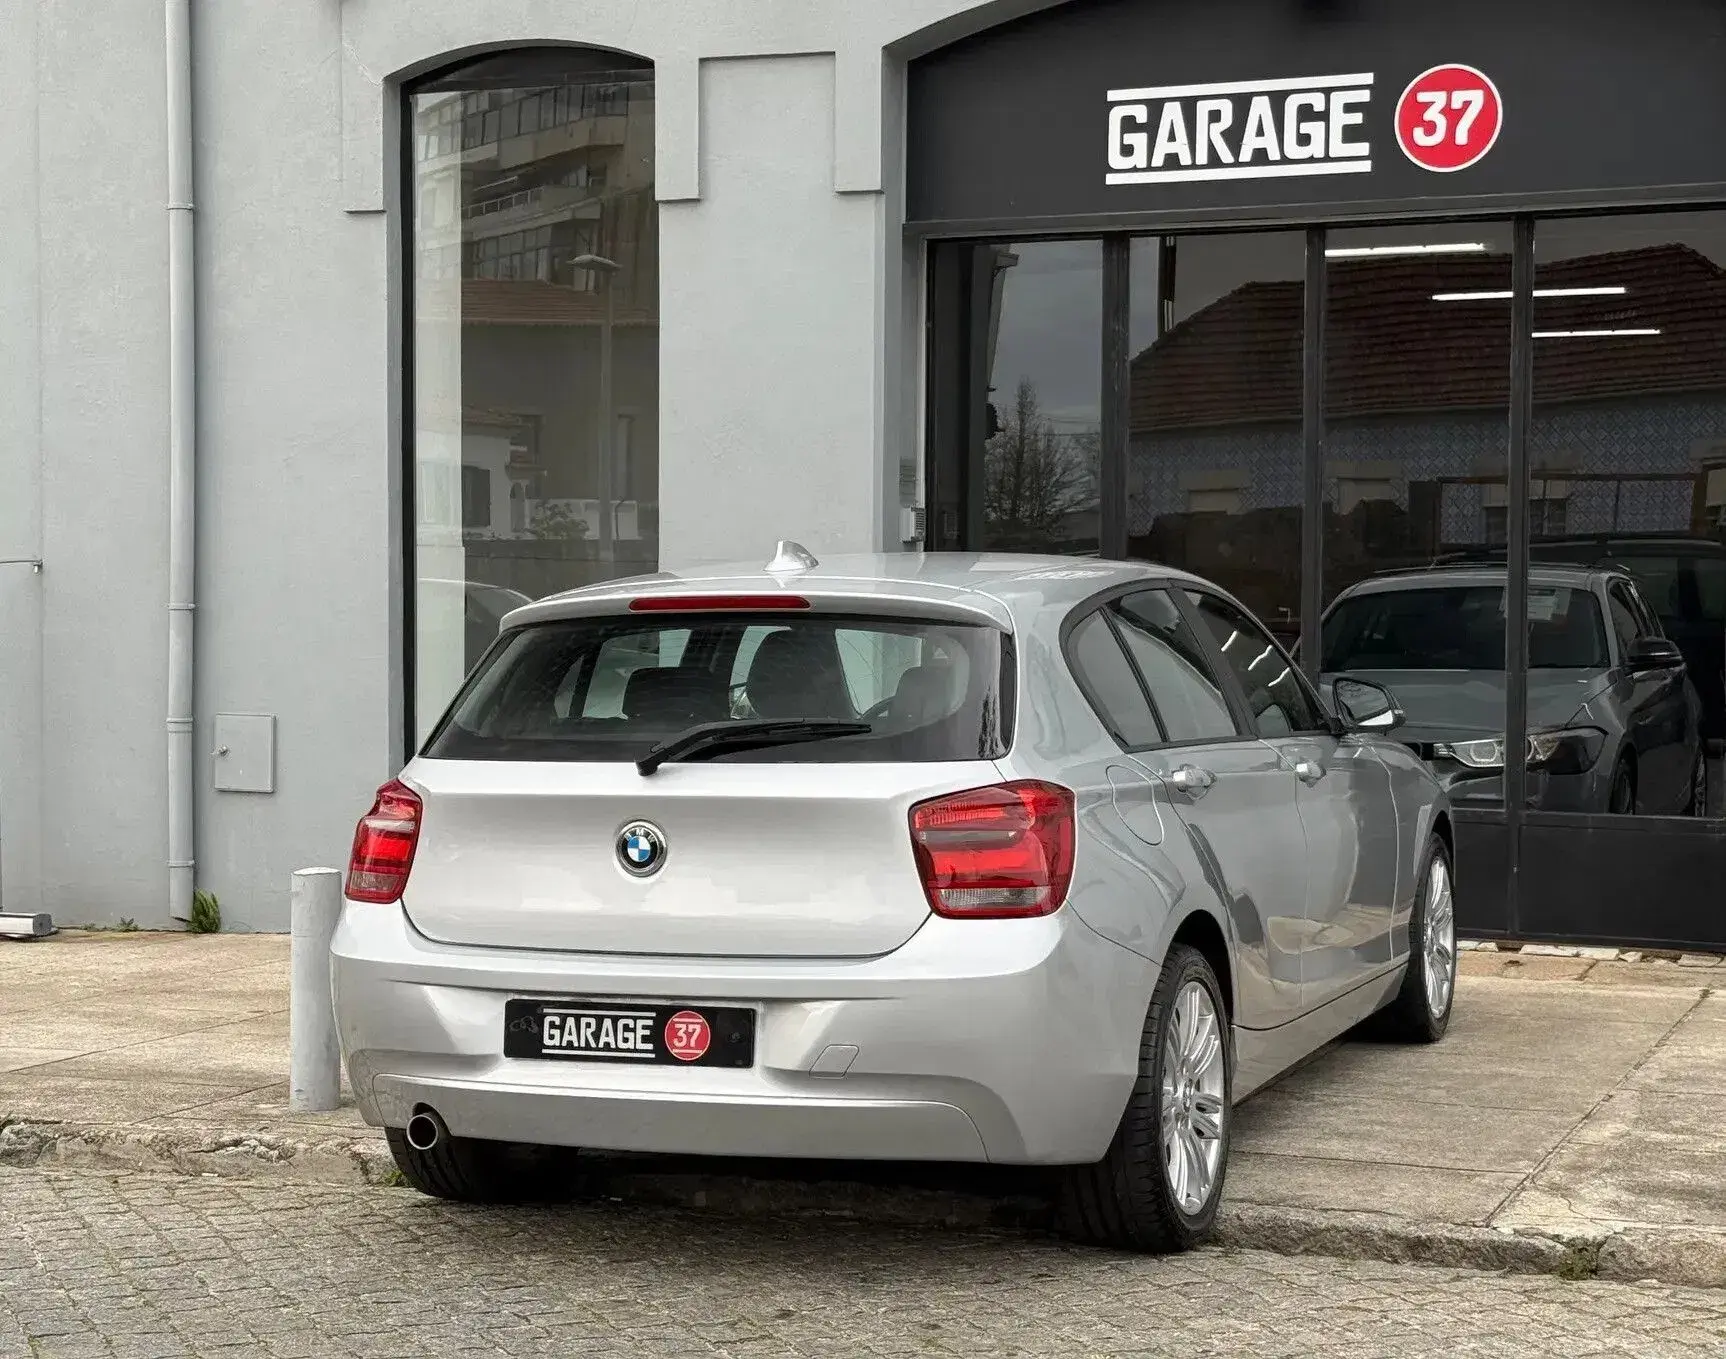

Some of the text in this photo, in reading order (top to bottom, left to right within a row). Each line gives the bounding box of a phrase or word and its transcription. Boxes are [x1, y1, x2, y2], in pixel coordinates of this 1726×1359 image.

[1107, 89, 1485, 170] GARAGE 37
[623, 827, 656, 843] BMW
[543, 1016, 702, 1050] GARAGE 37
